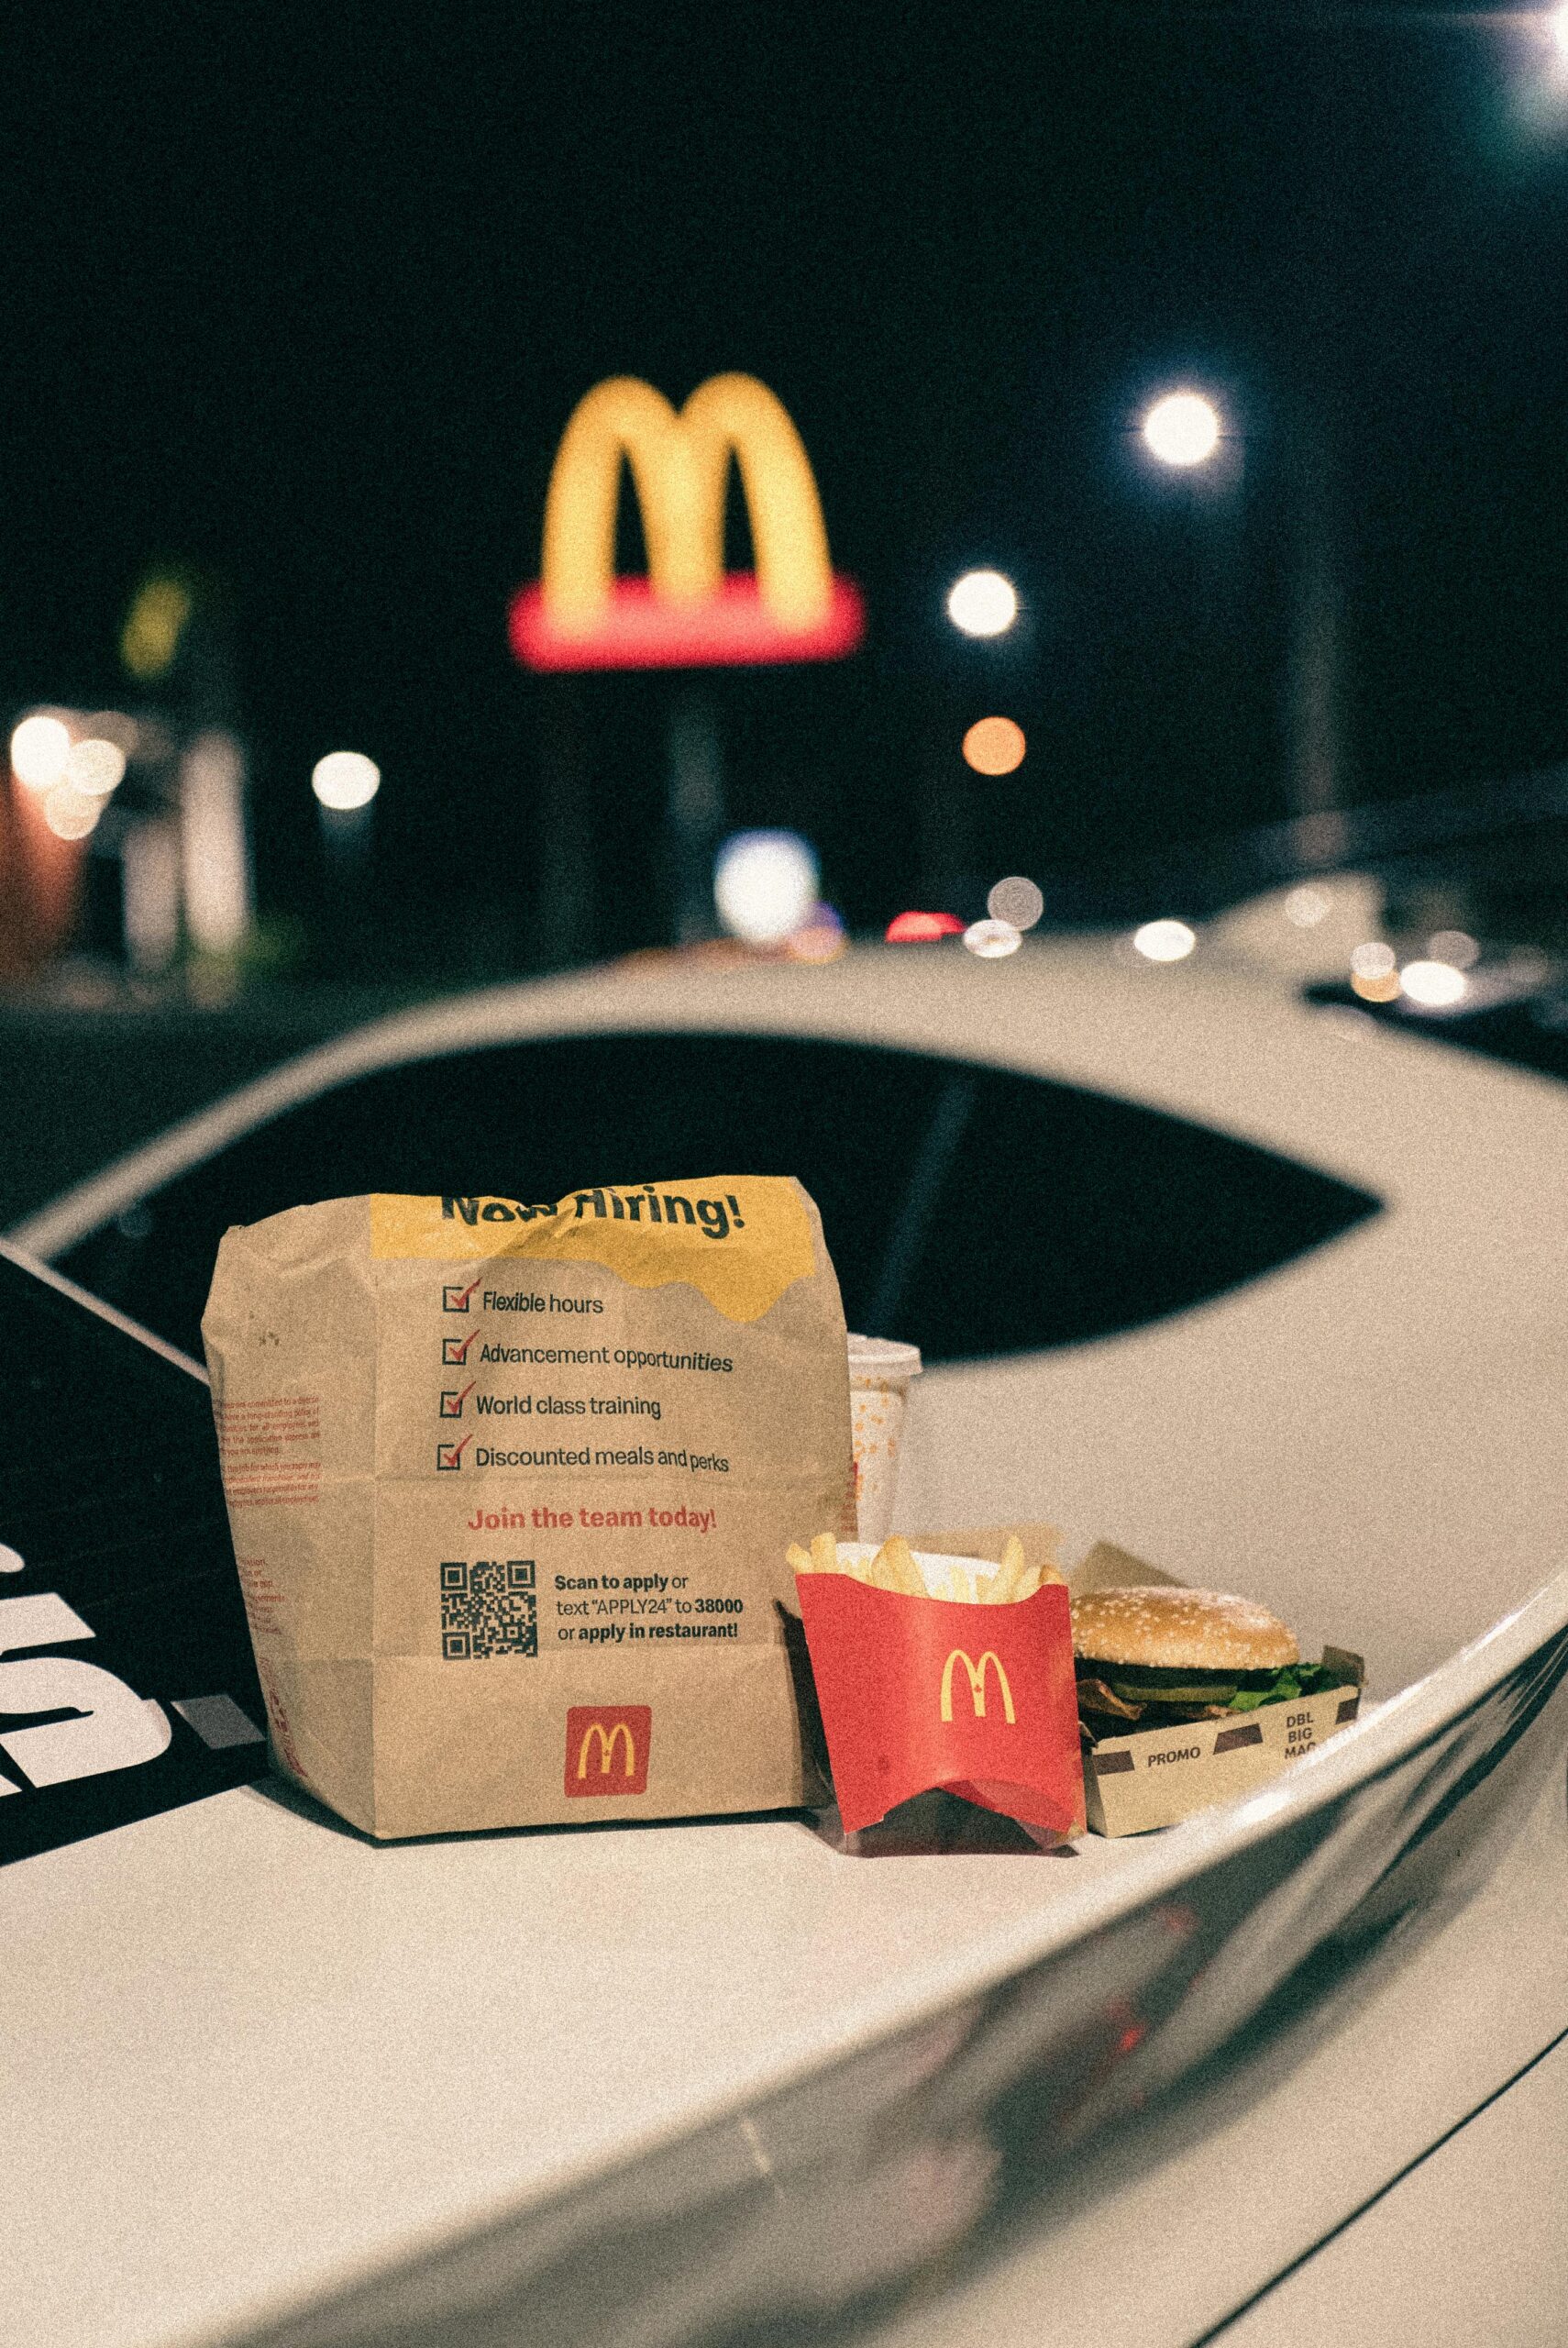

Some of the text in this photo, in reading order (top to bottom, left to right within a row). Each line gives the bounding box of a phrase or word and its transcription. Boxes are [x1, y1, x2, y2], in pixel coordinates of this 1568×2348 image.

[572, 1185, 745, 1239] Hiring!
[482, 1291, 603, 1313] Flexible hours
[480, 1344, 733, 1372] Advancement opportunities
[476, 1395, 661, 1419] World class training
[476, 1446, 730, 1472] Discounted meals and perks
[468, 1505, 718, 1534] Join the team today!
[555, 1574, 689, 1592] Scan to apply or
[557, 1600, 590, 1616] text
[675, 1599, 692, 1613] to
[694, 1598, 744, 1613] 38000
[558, 1622, 739, 1644] or apply in restaurant!
[1286, 1711, 1314, 1728] DBL
[1288, 1727, 1313, 1744] BIG
[1147, 1746, 1202, 1767] PROMO
